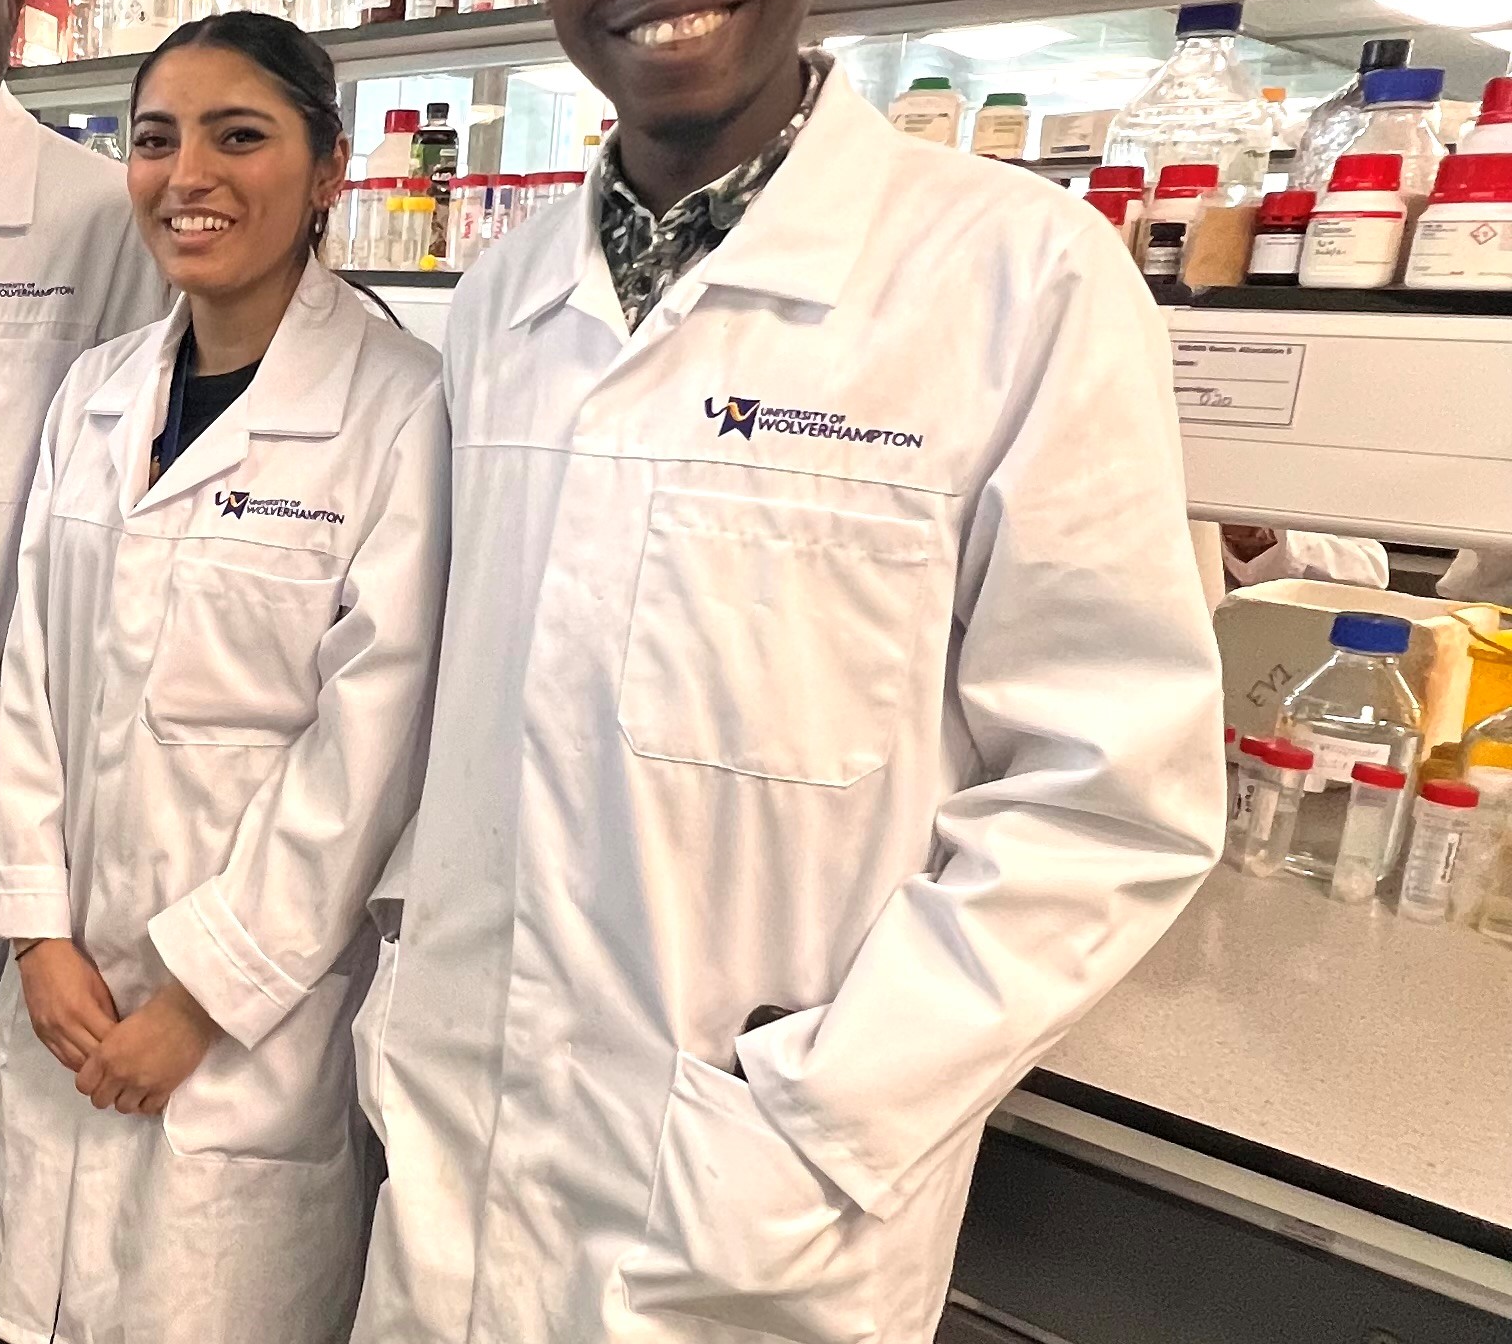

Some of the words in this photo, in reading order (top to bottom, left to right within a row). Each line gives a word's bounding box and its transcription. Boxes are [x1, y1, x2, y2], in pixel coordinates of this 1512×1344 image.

[760, 407, 828, 422] UNIVERSITY
[828, 413, 846, 425] OF
[758, 416, 924, 449] WOLVERHAMPTON
[289, 500, 302, 508] OF
[246, 506, 346, 525] WOLVERHAMPTON
